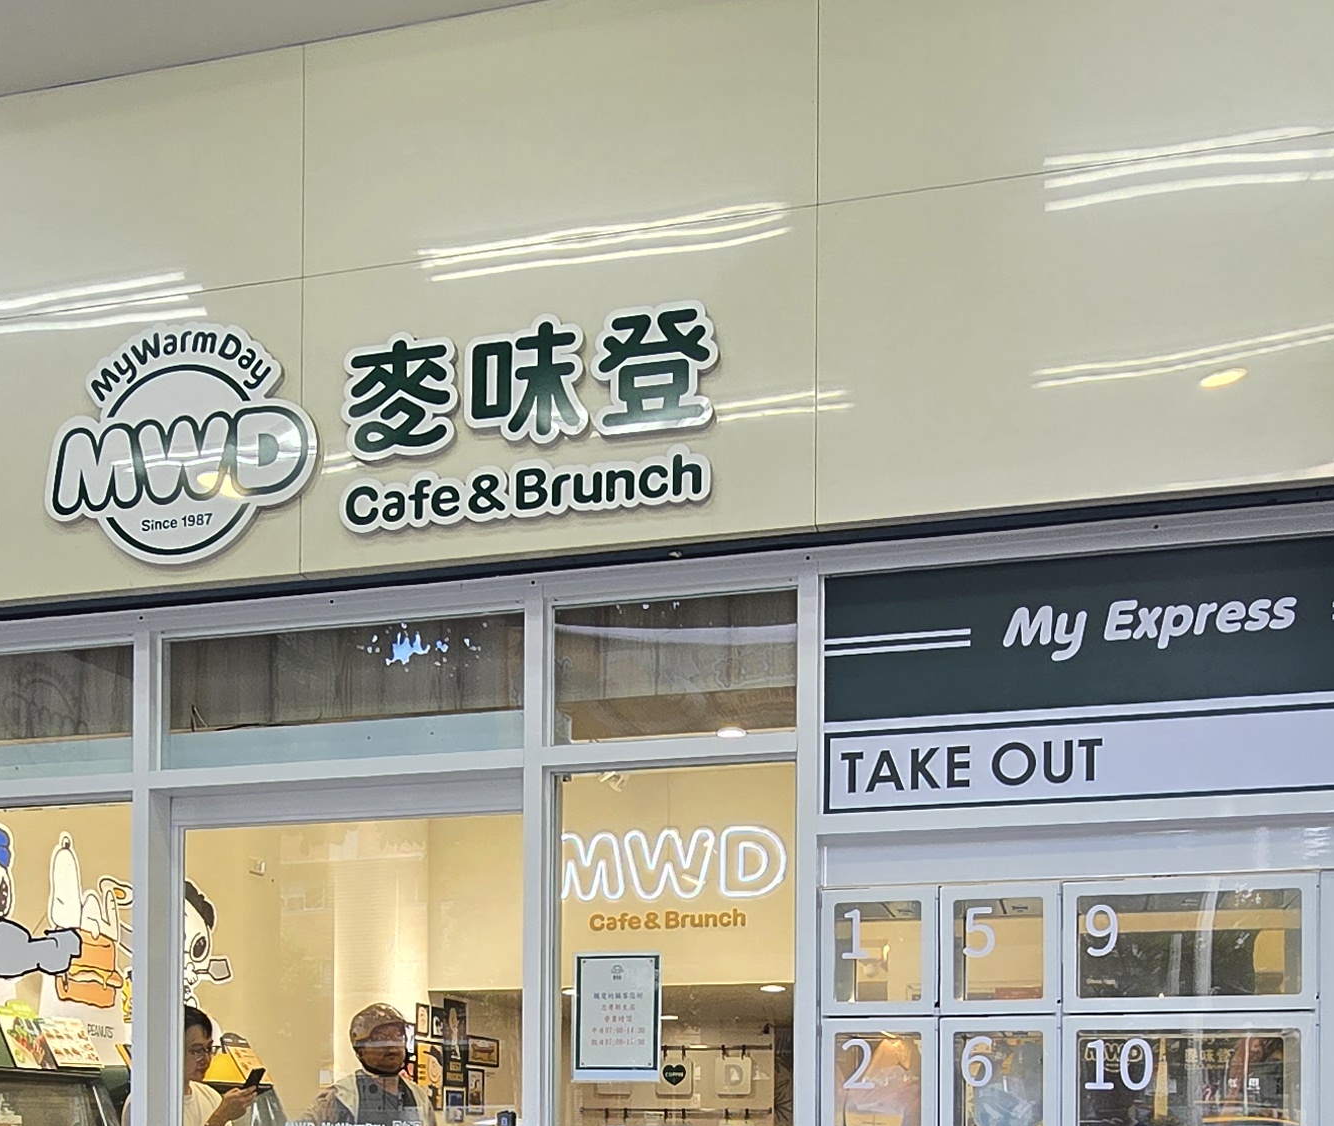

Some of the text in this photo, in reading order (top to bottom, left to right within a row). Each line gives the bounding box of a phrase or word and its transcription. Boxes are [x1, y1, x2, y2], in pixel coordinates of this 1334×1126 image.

[90, 329, 272, 402] MyWarmDay
[350, 308, 710, 453] 麥味登
[54, 405, 307, 515] MWD
[141, 512, 212, 531] Since 1987
[1002, 596, 1298, 662] My Express
[840, 738, 1103, 794] TAKE OUT
[561, 826, 787, 901] MWD
[842, 909, 867, 959] 1
[962, 907, 995, 957] 5
[1085, 904, 1118, 956] 9
[842, 1039, 874, 1090] 2
[961, 1036, 993, 1086] 6
[1084, 1038, 1153, 1091] 10
